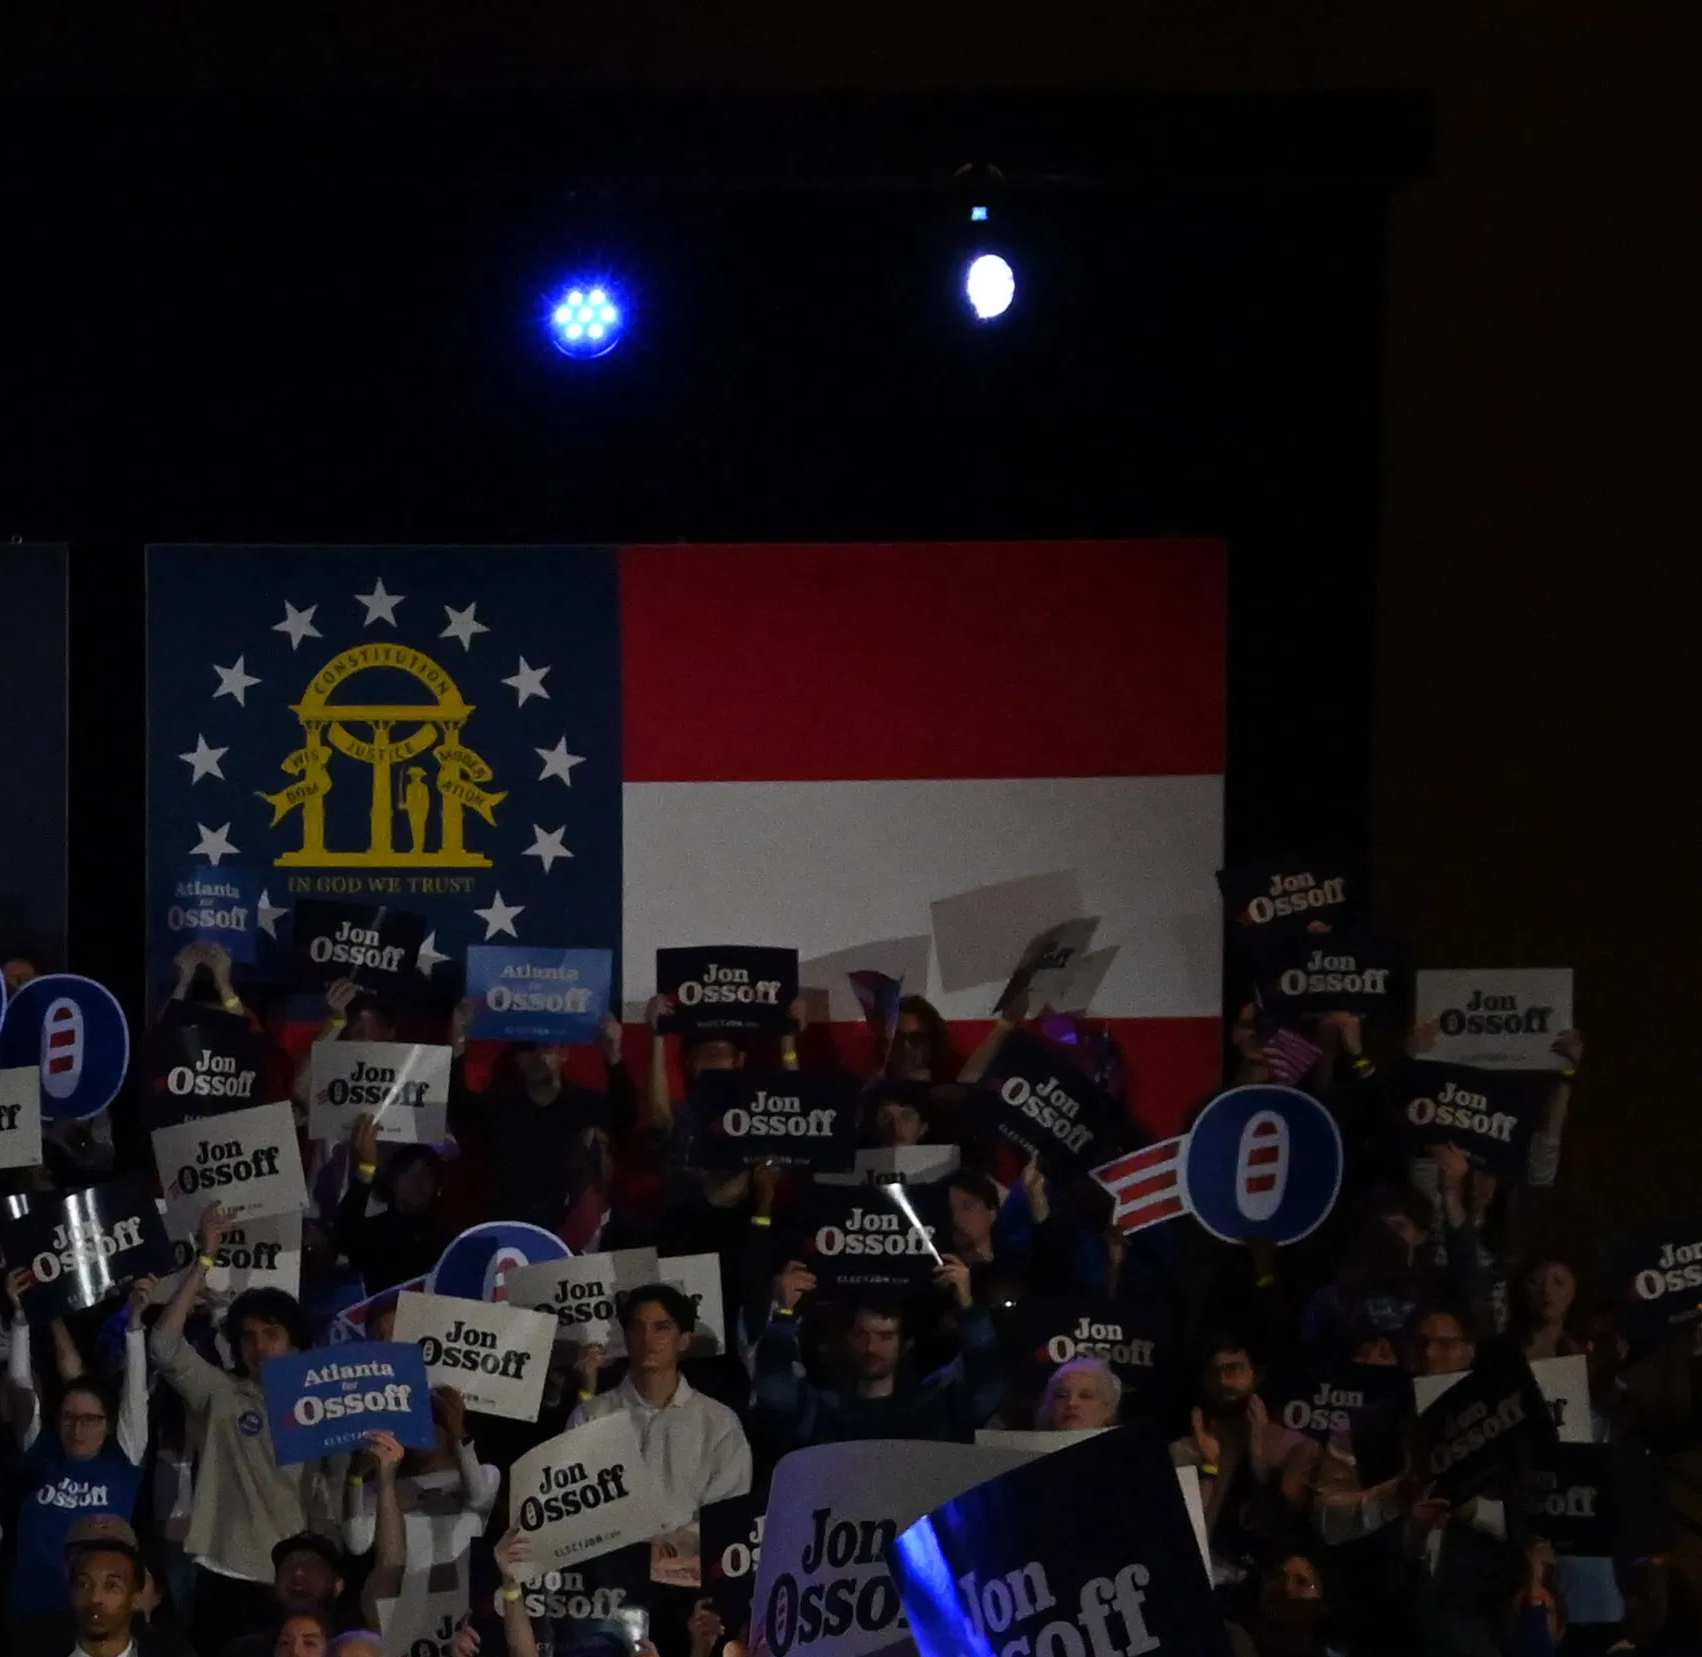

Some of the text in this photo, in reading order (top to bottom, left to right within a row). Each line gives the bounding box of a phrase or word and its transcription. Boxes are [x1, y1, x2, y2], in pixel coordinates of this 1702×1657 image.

[313, 646, 449, 695] CONSTITUTION
[345, 741, 413, 762] JUSTICE
[175, 881, 241, 900] Atlanta
[288, 877, 475, 893] IN GOD WE TRUST
[1247, 877, 1347, 925] Ossoff
[167, 902, 250, 932] Ossoff
[334, 921, 381, 947] Jon
[309, 935, 406, 973] Ossoff
[1307, 951, 1357, 973] Jon
[501, 965, 580, 982] Atlanta
[703, 962, 750, 987] Jon
[1279, 966, 1390, 996] Ossoff
[486, 985, 592, 1014] Ossoff
[677, 978, 782, 1006] Ossoff
[1465, 990, 1516, 1012] Jon
[1439, 1005, 1554, 1035] Ossoff
[195, 1048, 238, 1074] Jon
[350, 1061, 398, 1082] Jon
[166, 1065, 256, 1099] Ossoff
[1436, 1081, 1488, 1109] Jon
[750, 1089, 802, 1114] Jon
[1036, 1076, 1080, 1122] Jon
[722, 1106, 837, 1139] Ossoff
[999, 1074, 1096, 1156] Ossoff
[1406, 1098, 1519, 1142] Ossoff
[195, 1137, 244, 1165] Jon
[178, 1148, 280, 1192] Ossoff
[845, 1207, 901, 1235] Jon
[444, 1319, 498, 1349] Jon
[1073, 1317, 1123, 1341] Jon
[417, 1336, 532, 1380] Ossoff
[303, 1360, 394, 1386] Atlanta
[292, 1384, 412, 1427] Ossoff
[538, 1459, 588, 1495] Jon
[519, 1464, 630, 1533] Ossoff
[801, 1506, 898, 1575] Jon
